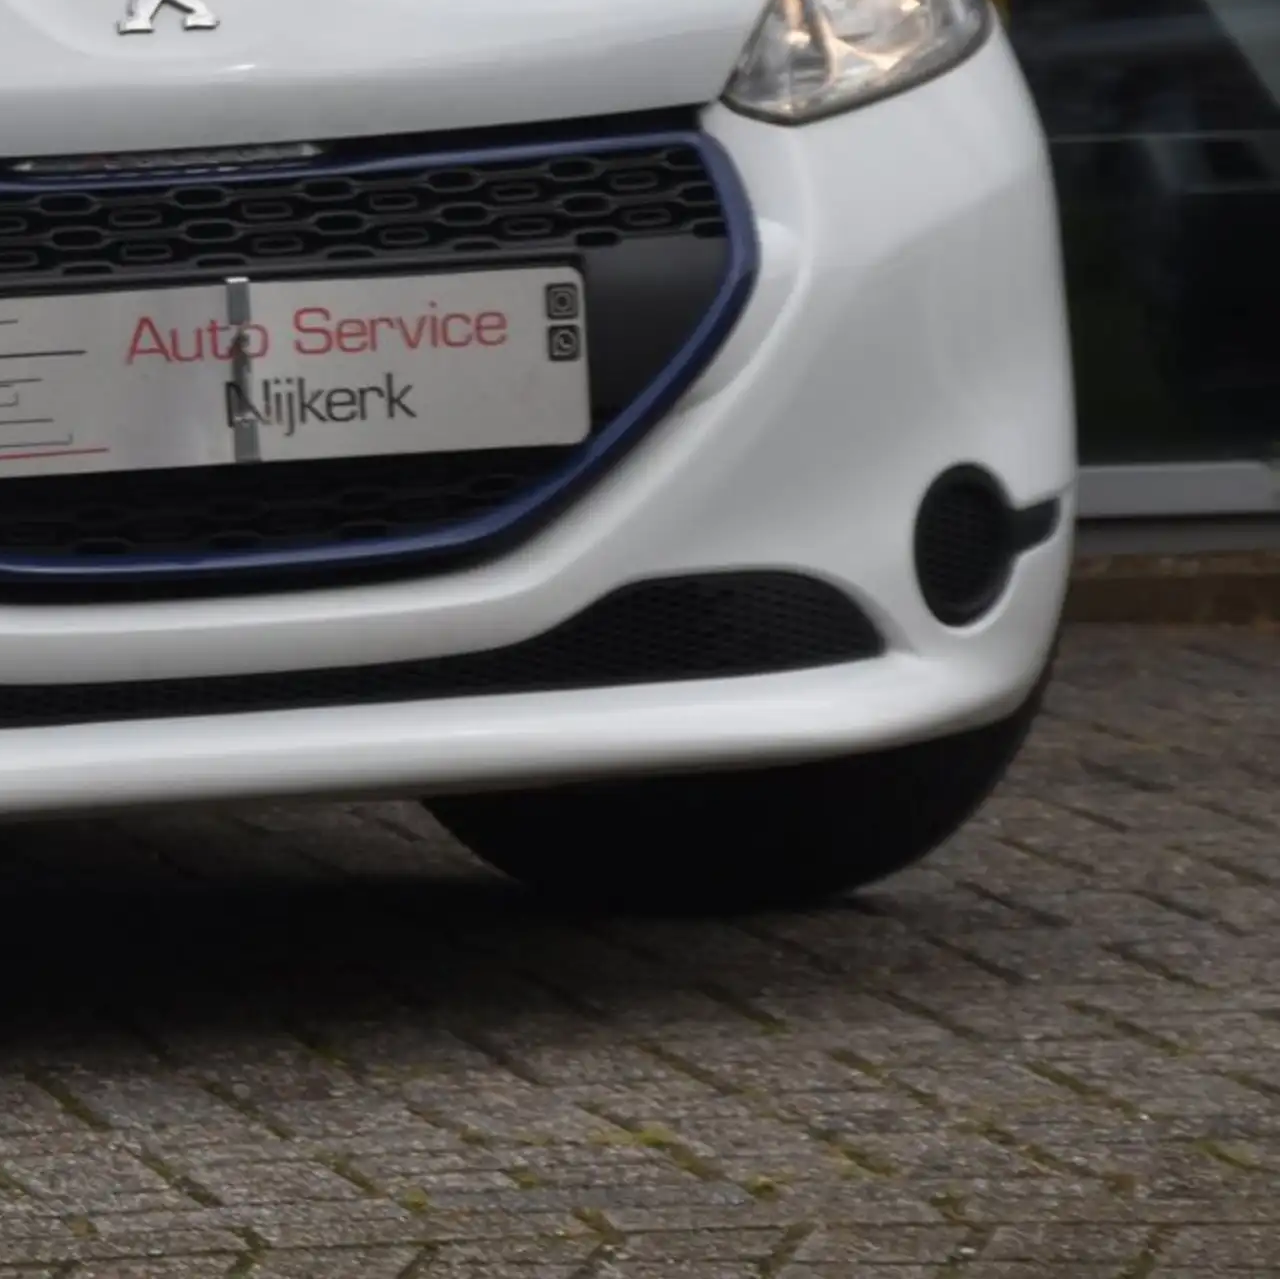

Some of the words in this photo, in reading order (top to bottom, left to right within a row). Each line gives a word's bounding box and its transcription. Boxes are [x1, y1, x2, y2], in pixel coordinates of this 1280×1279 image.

[125, 315, 270, 365] Auto
[292, 300, 508, 355] Service
[225, 372, 417, 437] Nijkerk
